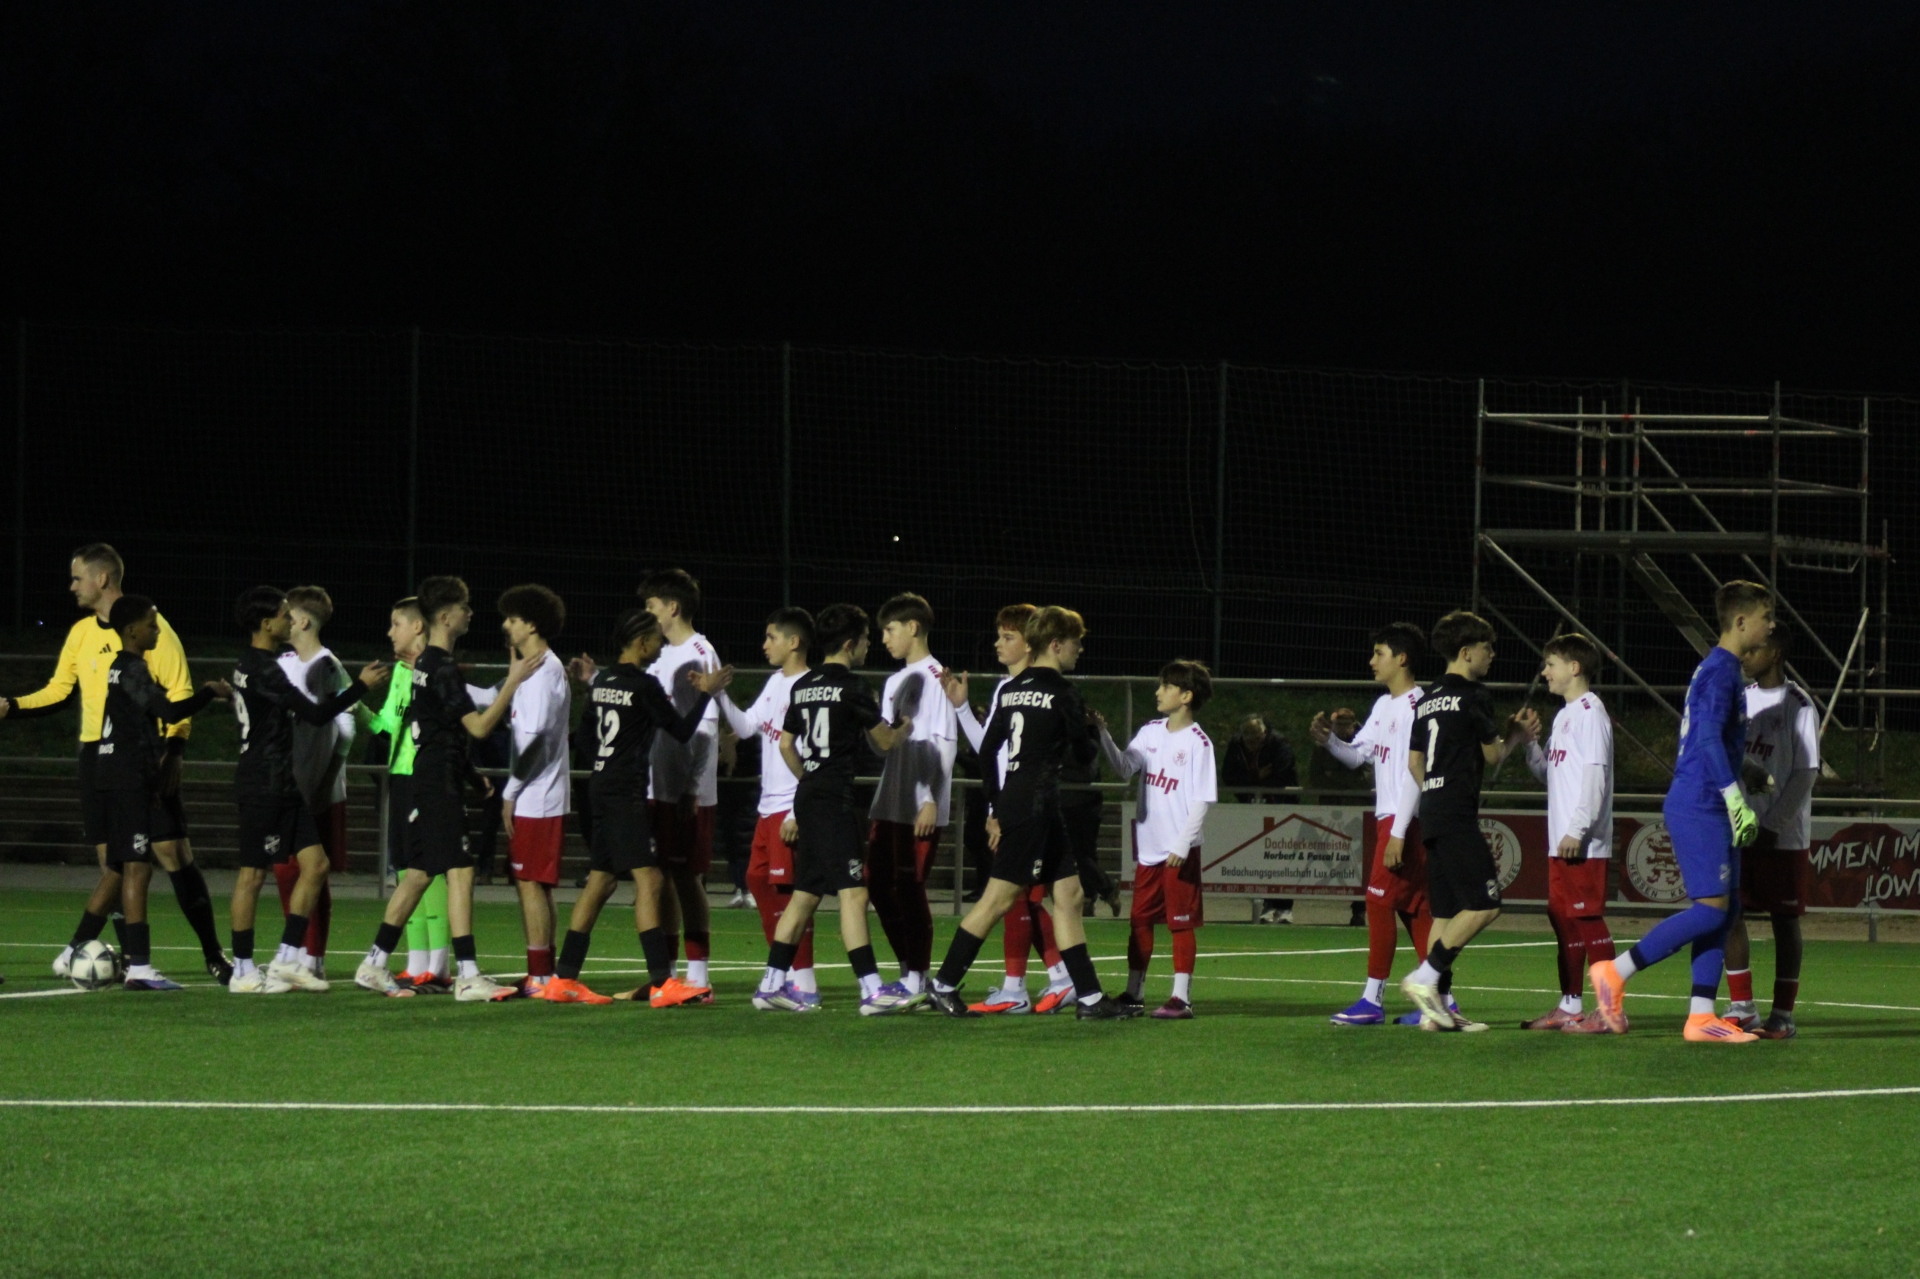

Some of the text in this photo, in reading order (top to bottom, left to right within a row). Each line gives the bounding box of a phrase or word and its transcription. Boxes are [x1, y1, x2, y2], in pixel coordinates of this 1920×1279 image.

[592, 687, 634, 707] WIESECK
[794, 686, 843, 705] WIESECK
[1001, 690, 1055, 709] WIESECK
[1417, 696, 1462, 720] WIESECK
[596, 706, 620, 758] 12
[801, 707, 830, 759] 14
[1145, 768, 1179, 795] mhp
[1264, 837, 1351, 850] Dachdeckermeister
[1808, 830, 1920, 875] MMEN IM
[1263, 851, 1350, 861] Norbert & Pascal Lux
[1221, 867, 1355, 879] Bedachungsgesellschaft Lux GmbH
[1629, 863, 1659, 898] HESSEN
[1862, 865, 1920, 903] LÖW
